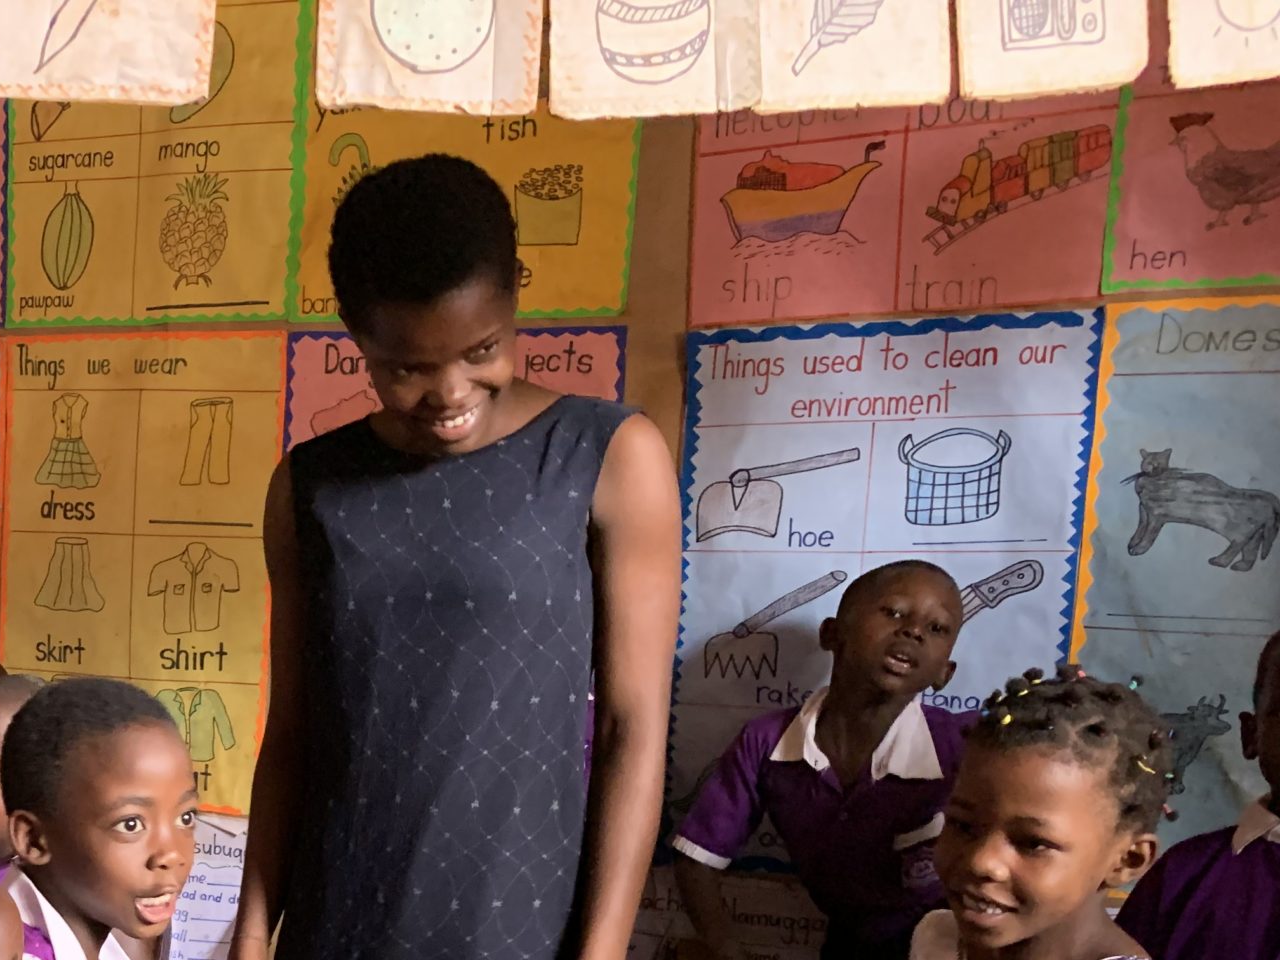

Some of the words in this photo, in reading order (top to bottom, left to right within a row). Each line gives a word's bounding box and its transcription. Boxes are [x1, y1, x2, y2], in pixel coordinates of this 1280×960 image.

[28, 150, 114, 182] sugarcane
[159, 139, 220, 173] mango
[1129, 239, 1187, 270] hen
[722, 263, 793, 318] ship
[905, 264, 998, 311] train
[19, 294, 75, 317] pawpaw
[17, 343, 65, 390] Things
[87, 358, 111, 375] we
[133, 357, 188, 375] wear
[524, 341, 593, 377] jects
[708, 343, 785, 395] Things
[803, 338, 865, 376] used
[880, 336, 908, 371] to
[924, 333, 998, 368] clean
[1019, 342, 1068, 366] our
[790, 379, 957, 419] environment
[40, 490, 95, 520] dress
[788, 518, 834, 547] hoe
[35, 634, 86, 665] skirt
[159, 638, 228, 671] shirt
[200, 892, 223, 903] and
